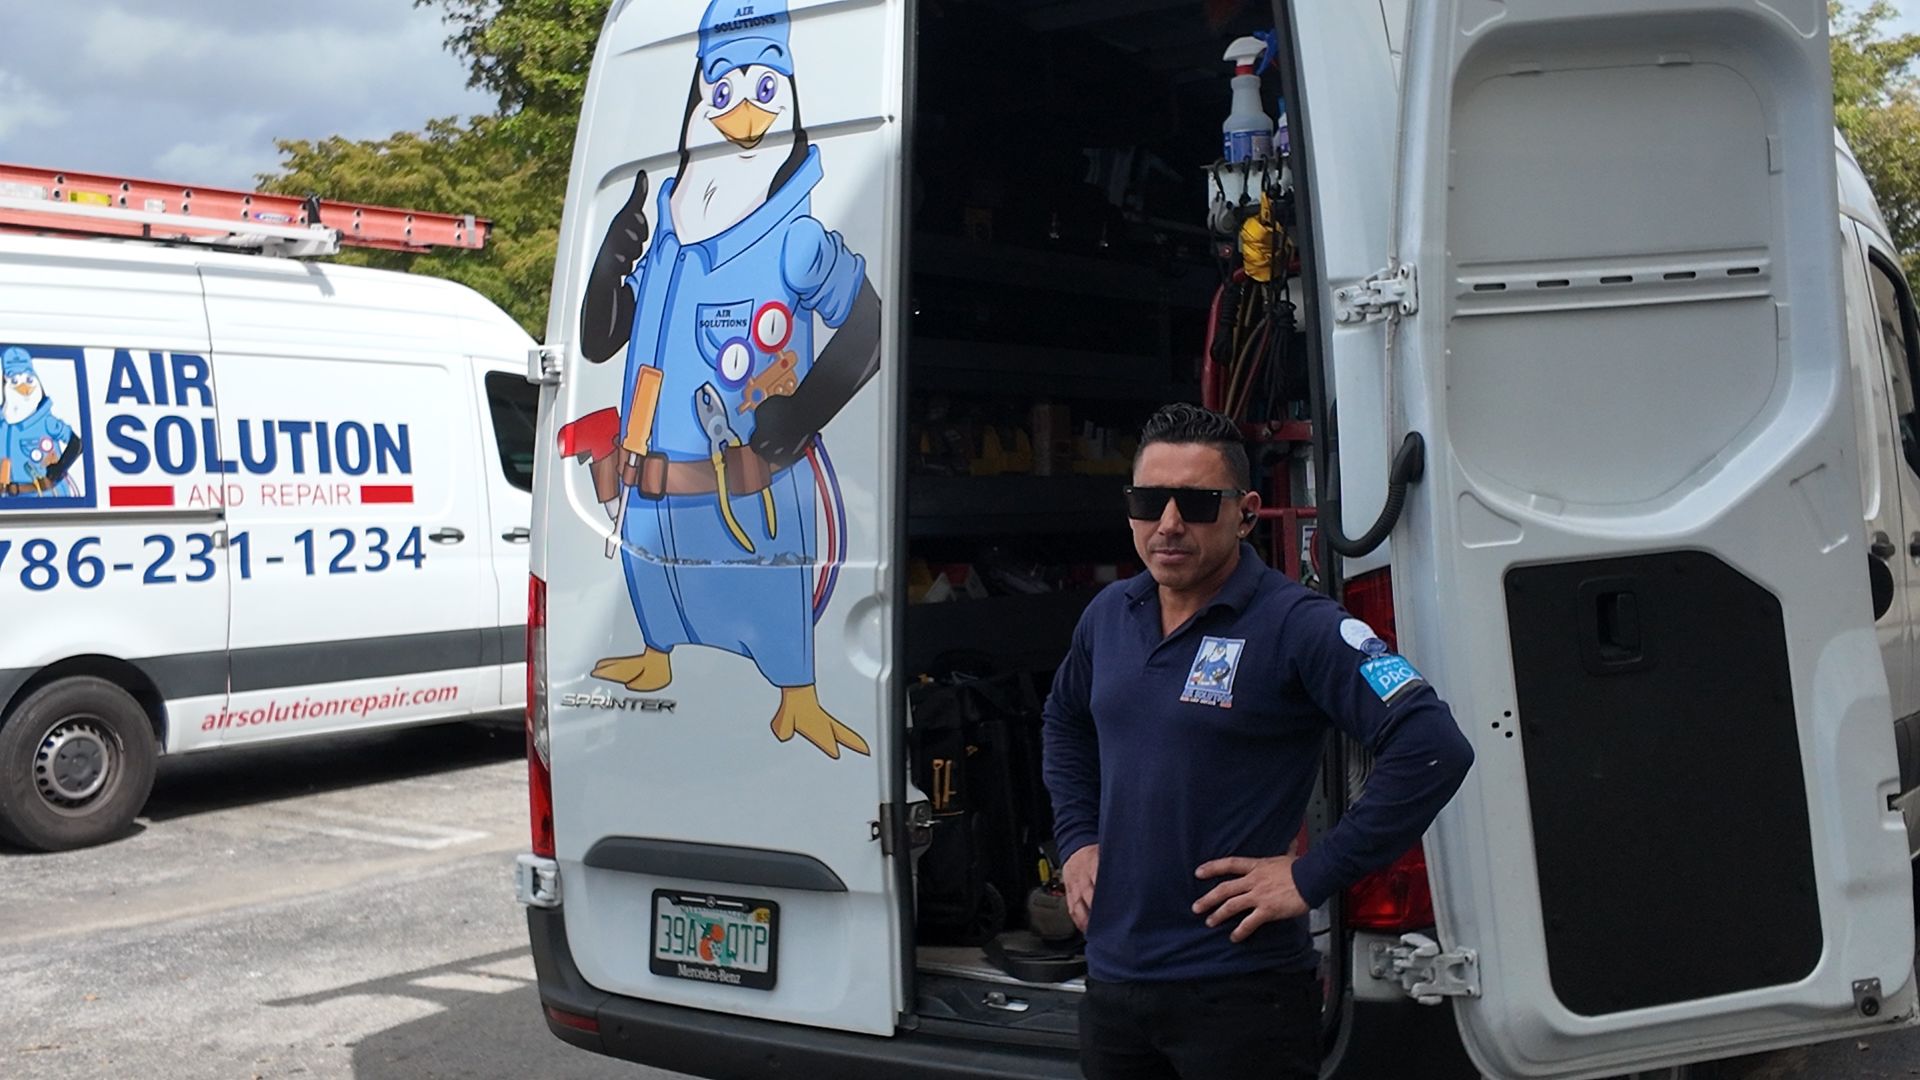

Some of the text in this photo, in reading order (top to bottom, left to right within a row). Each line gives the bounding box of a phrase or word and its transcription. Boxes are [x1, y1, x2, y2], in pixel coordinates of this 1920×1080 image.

[734, 5, 755, 18] AIR
[713, 14, 777, 34] SOLUTIONS
[700, 318, 748, 329] SOLUTIONS
[715, 309, 732, 318] AIR
[105, 348, 215, 407] AIR
[105, 414, 413, 476] SOLUTION
[188, 483, 352, 507] AND REPAIR
[1378, 667, 1414, 690] PRO
[201, 685, 459, 732] airsolutionrepair.com
[561, 692, 677, 714] SPRINTER
[660, 914, 768, 965] 39A QTP
[677, 963, 741, 985] Mercedes-Benz
